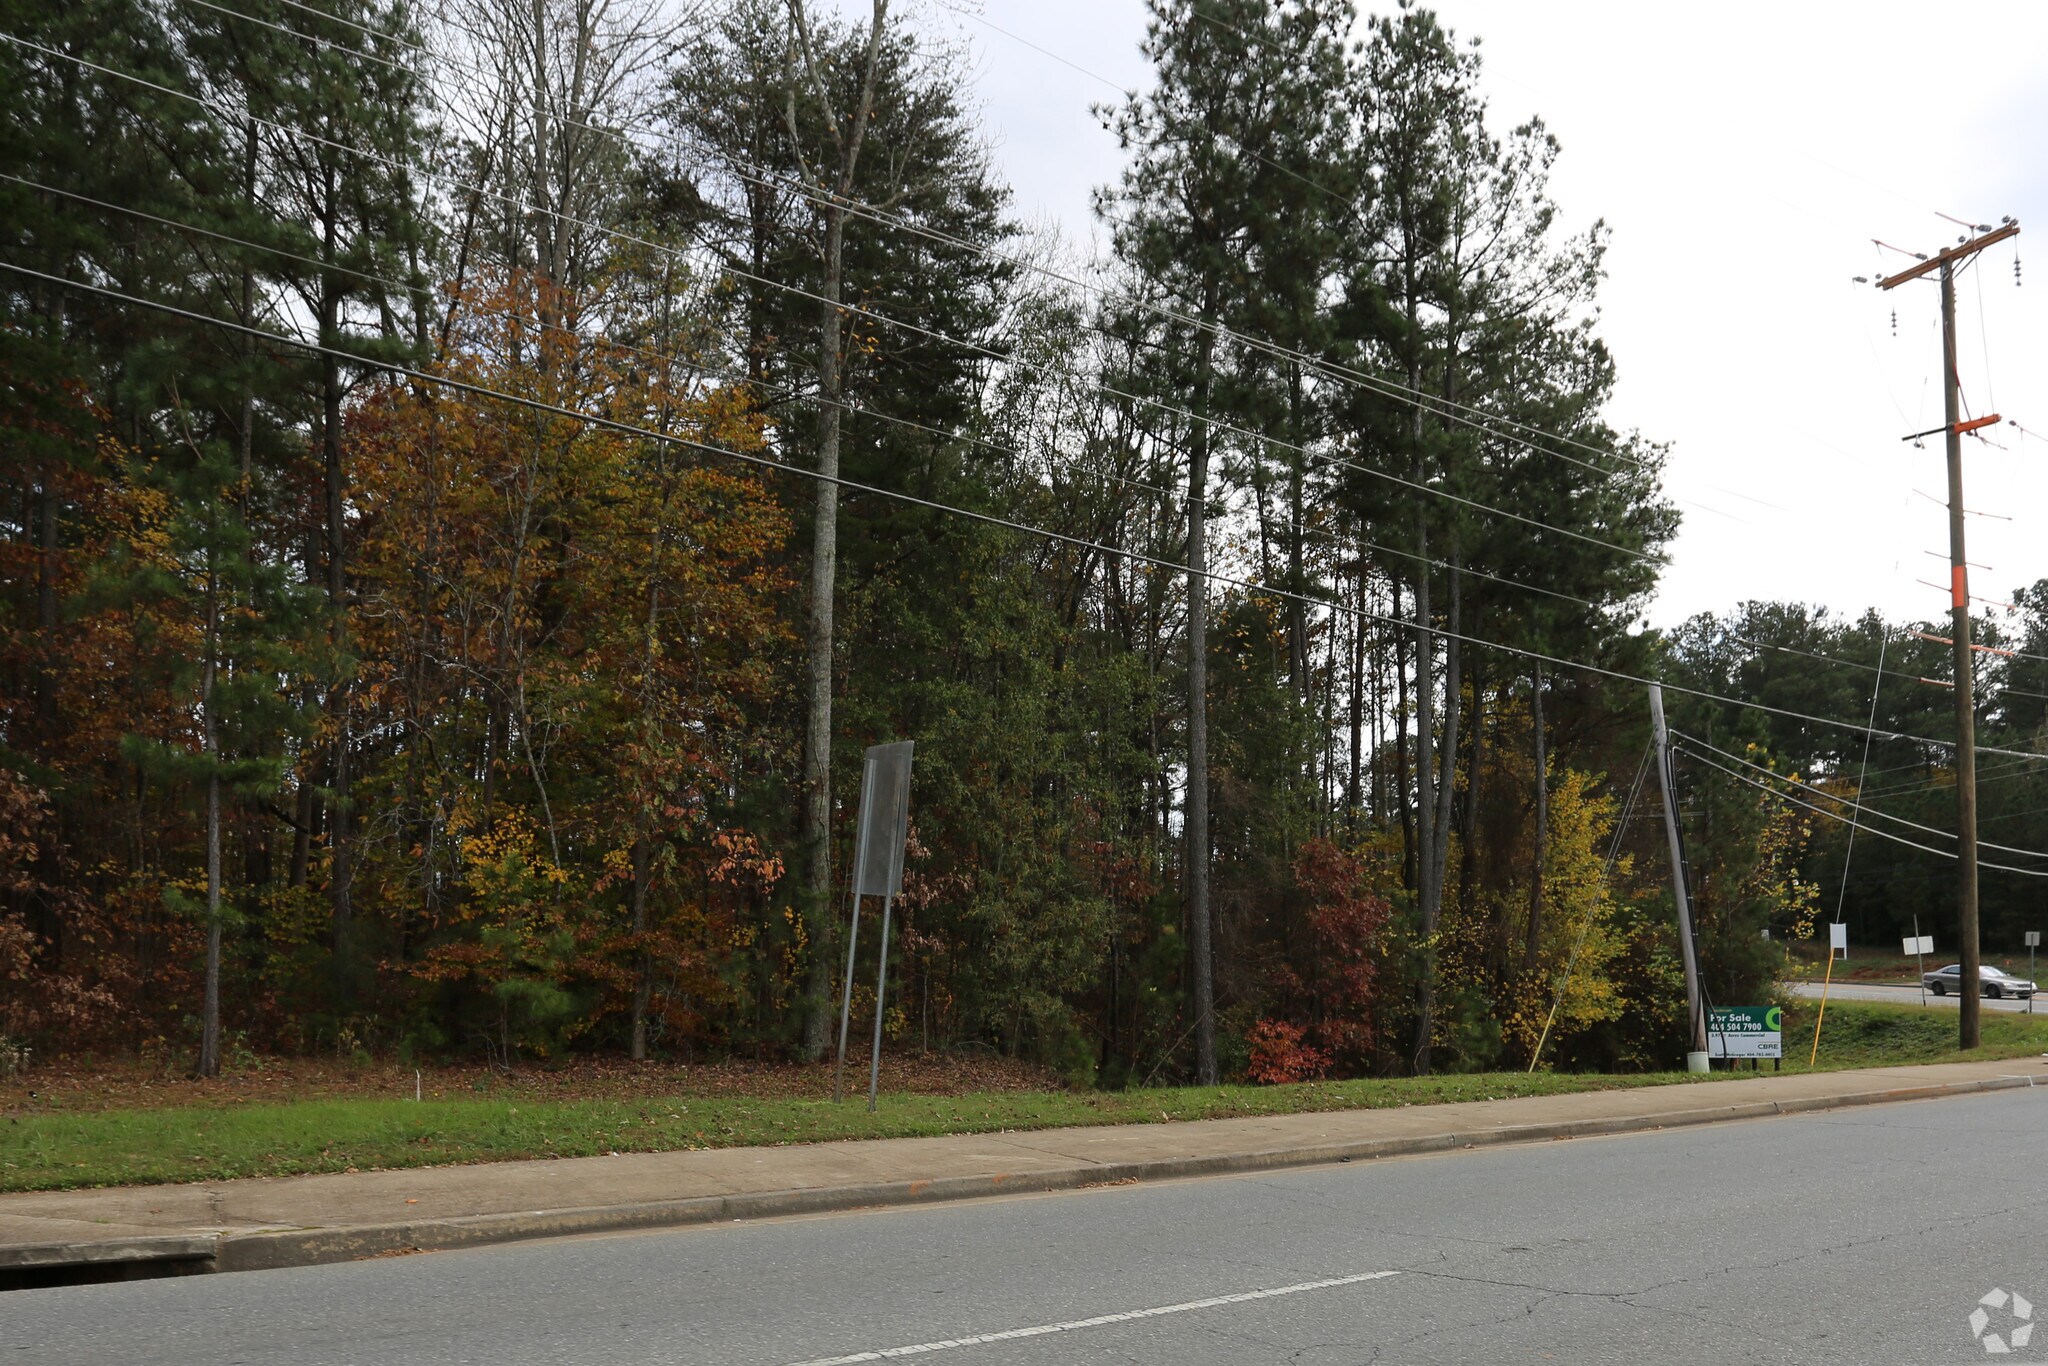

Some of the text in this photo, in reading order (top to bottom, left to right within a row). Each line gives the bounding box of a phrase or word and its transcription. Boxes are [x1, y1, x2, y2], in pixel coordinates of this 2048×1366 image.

[1710, 1014, 1751, 1022] For Sale
[1727, 1023, 1741, 1031] 504
[1743, 1023, 1762, 1031] 7900
